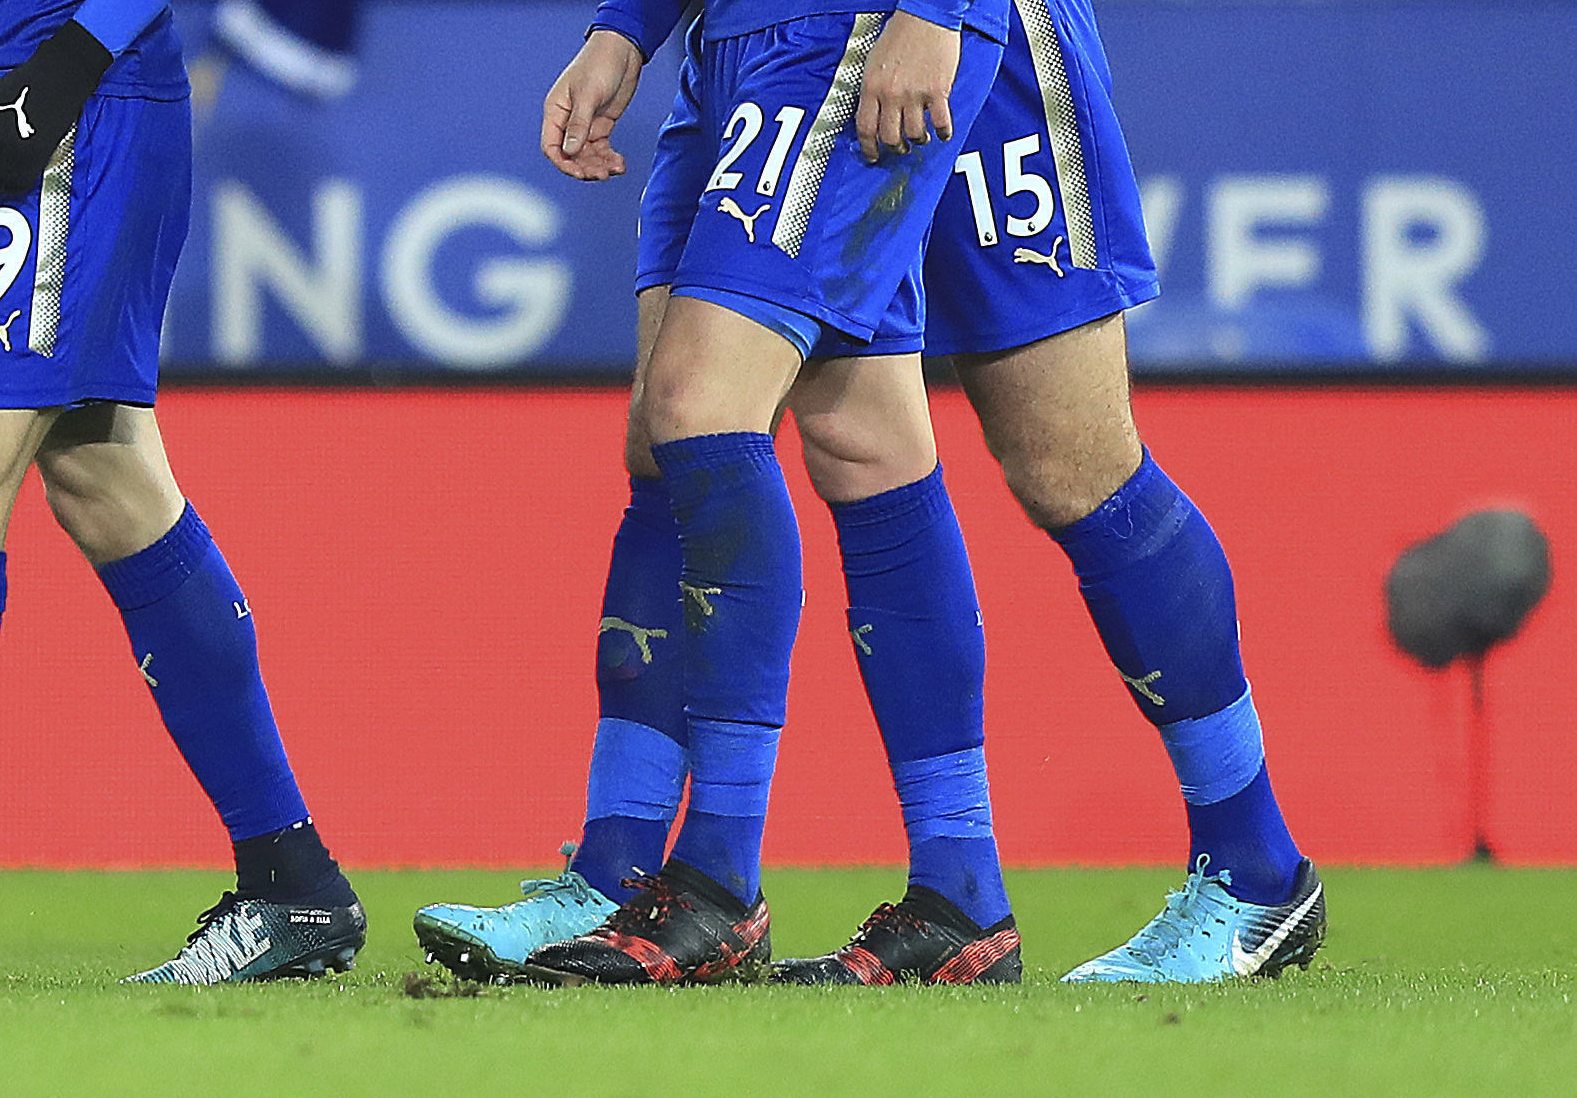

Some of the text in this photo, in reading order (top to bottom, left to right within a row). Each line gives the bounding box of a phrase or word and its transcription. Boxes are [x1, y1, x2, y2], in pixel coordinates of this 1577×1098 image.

[704, 102, 805, 197] 21
[954, 133, 1055, 247] 15
[209, 174, 575, 371] NG
